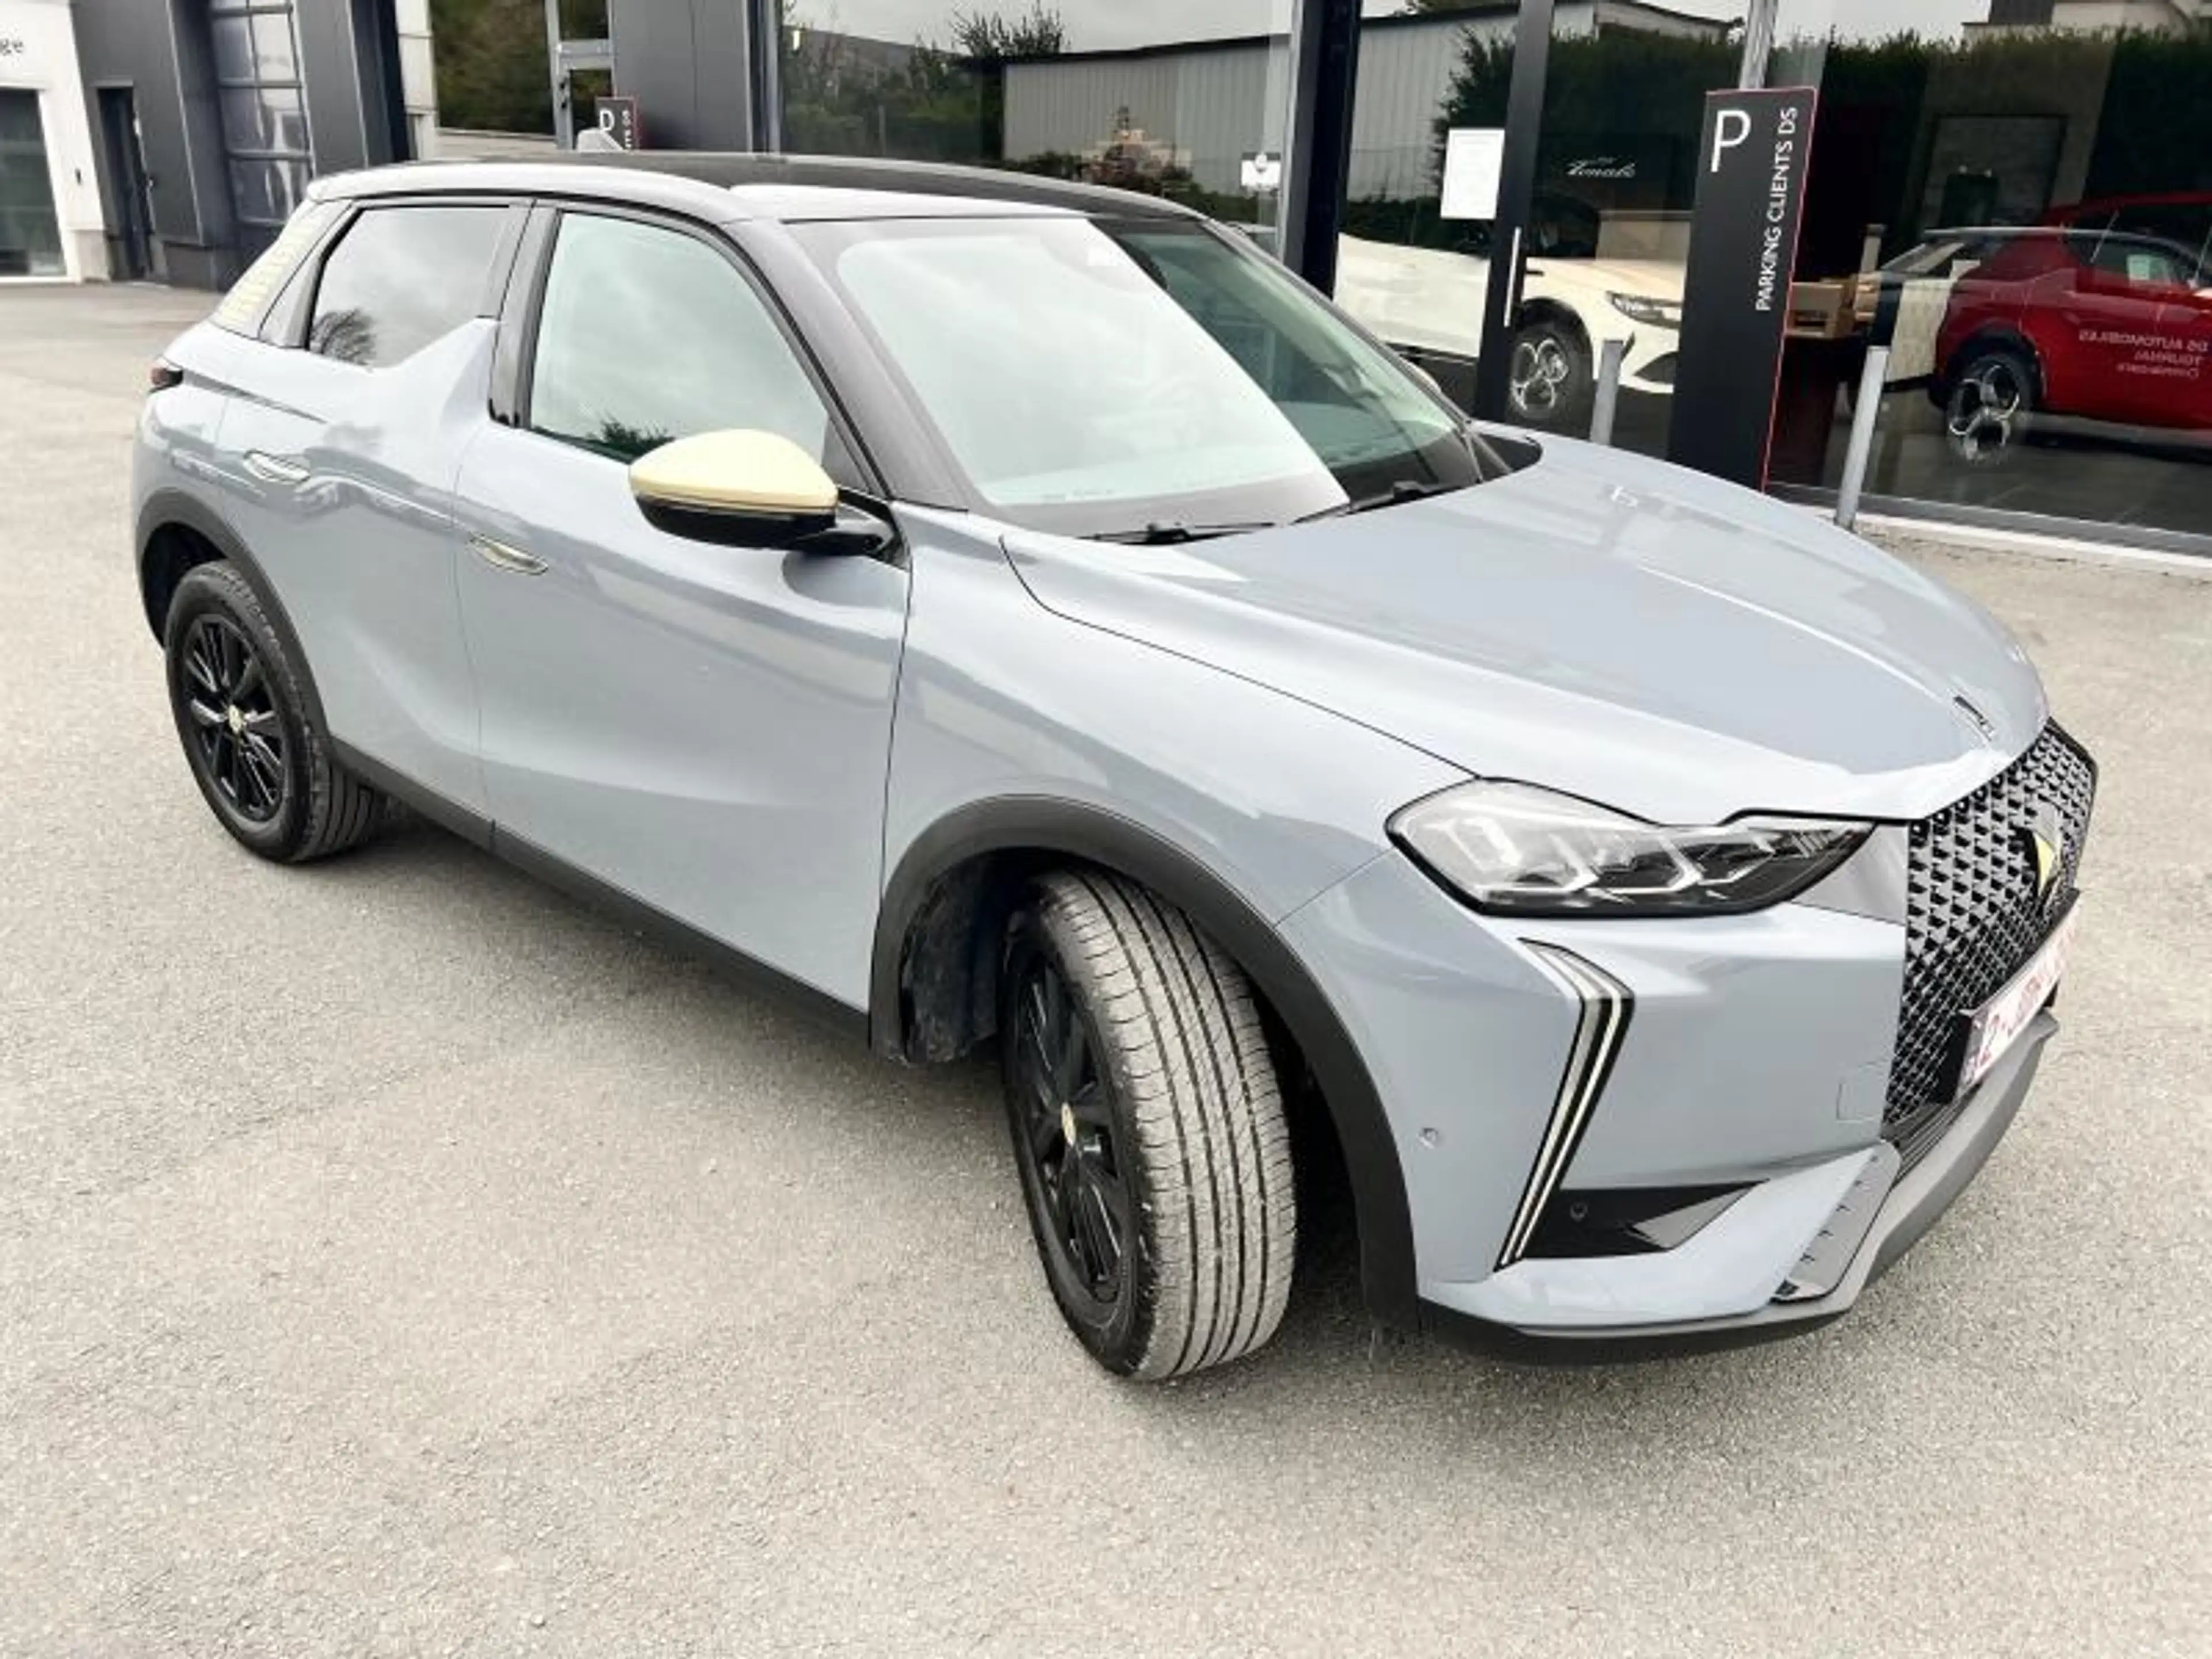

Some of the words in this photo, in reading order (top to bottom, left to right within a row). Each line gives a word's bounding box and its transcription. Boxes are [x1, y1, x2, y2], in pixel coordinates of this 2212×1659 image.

[1709, 108, 1752, 173] P
[1777, 107, 1798, 134] DS
[1766, 140, 1793, 222] CLIENTS
[1755, 226, 1782, 311] PARKING
